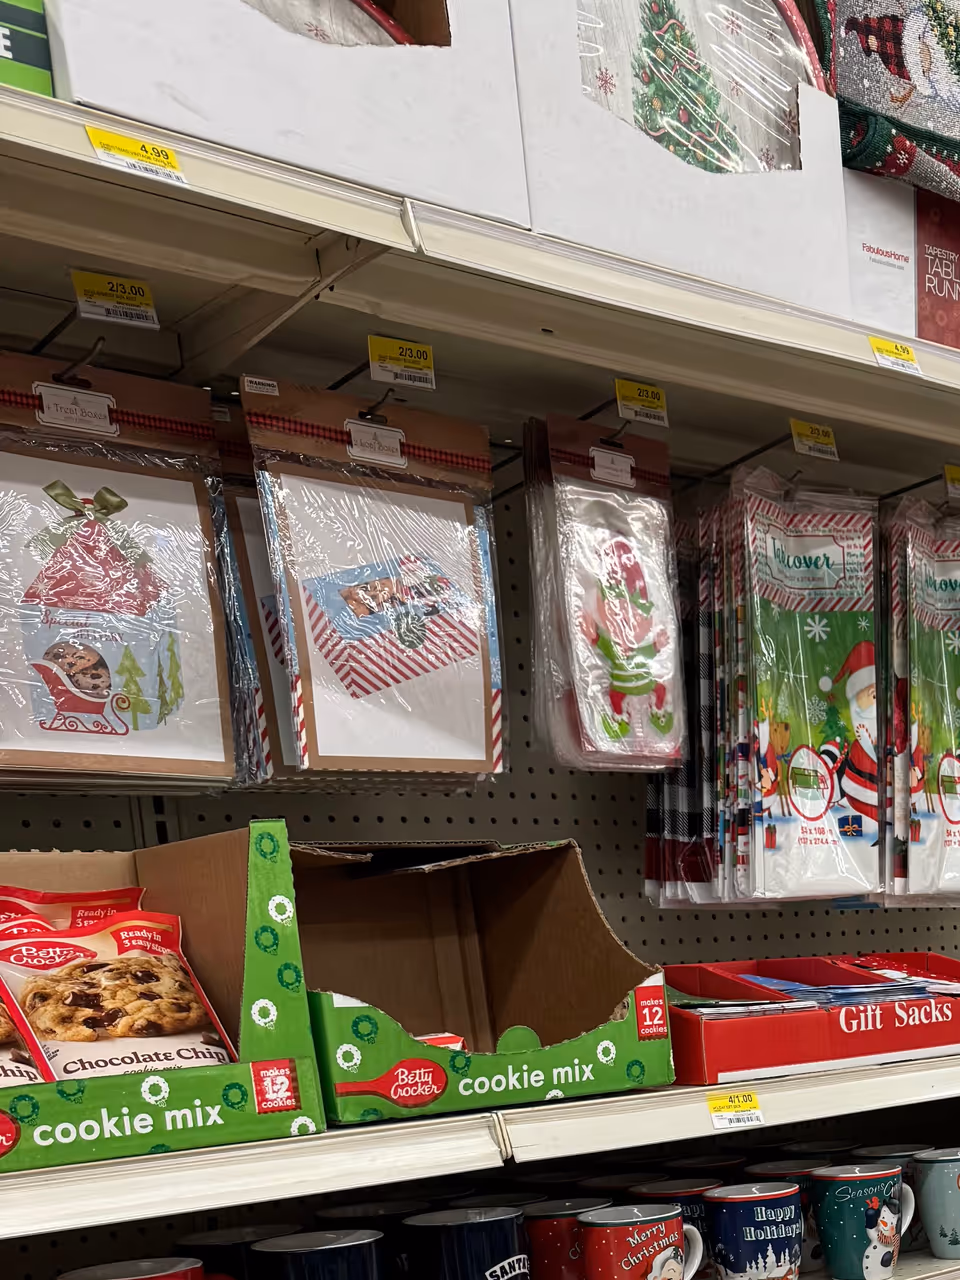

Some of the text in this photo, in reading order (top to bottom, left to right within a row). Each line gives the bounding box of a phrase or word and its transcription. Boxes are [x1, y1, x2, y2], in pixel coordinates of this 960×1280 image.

[140, 143, 169, 160] 4.99
[862, 243, 910, 263] FabulousHome
[925, 243, 960, 264] TAPESTRY
[107, 282, 145, 298] 2/3.00
[398, 346, 429, 361] 2/3.00
[637, 388, 661, 401] 2/3.00
[53, 402, 107, 420] Treat Boxes
[41, 609, 91, 631] Special
[77, 909, 107, 920] Ready
[120, 931, 163, 945] Ready in
[131, 940, 153, 953] easy
[640, 999, 664, 1007] makes
[641, 1006, 664, 1026] 12
[840, 999, 953, 1033] Gift Sacks
[640, 1026, 668, 1035] cookies
[63, 1048, 226, 1075] Chocolate Chip
[0, 1064, 39, 1083] hip
[260, 1068, 291, 1077] makes
[394, 1067, 434, 1085] Betty
[458, 1058, 595, 1097] cookie mix
[263, 1076, 292, 1100] 12
[390, 1083, 442, 1101] Crocker
[262, 1098, 297, 1108] cookies
[727, 1094, 753, 1104] 4/1.00
[33, 1099, 226, 1147] cookie mix
[834, 1183, 885, 1202] Seasons
[753, 1205, 797, 1221] Happy
[626, 1222, 667, 1248] Merry
[620, 1230, 679, 1271] Christmas
